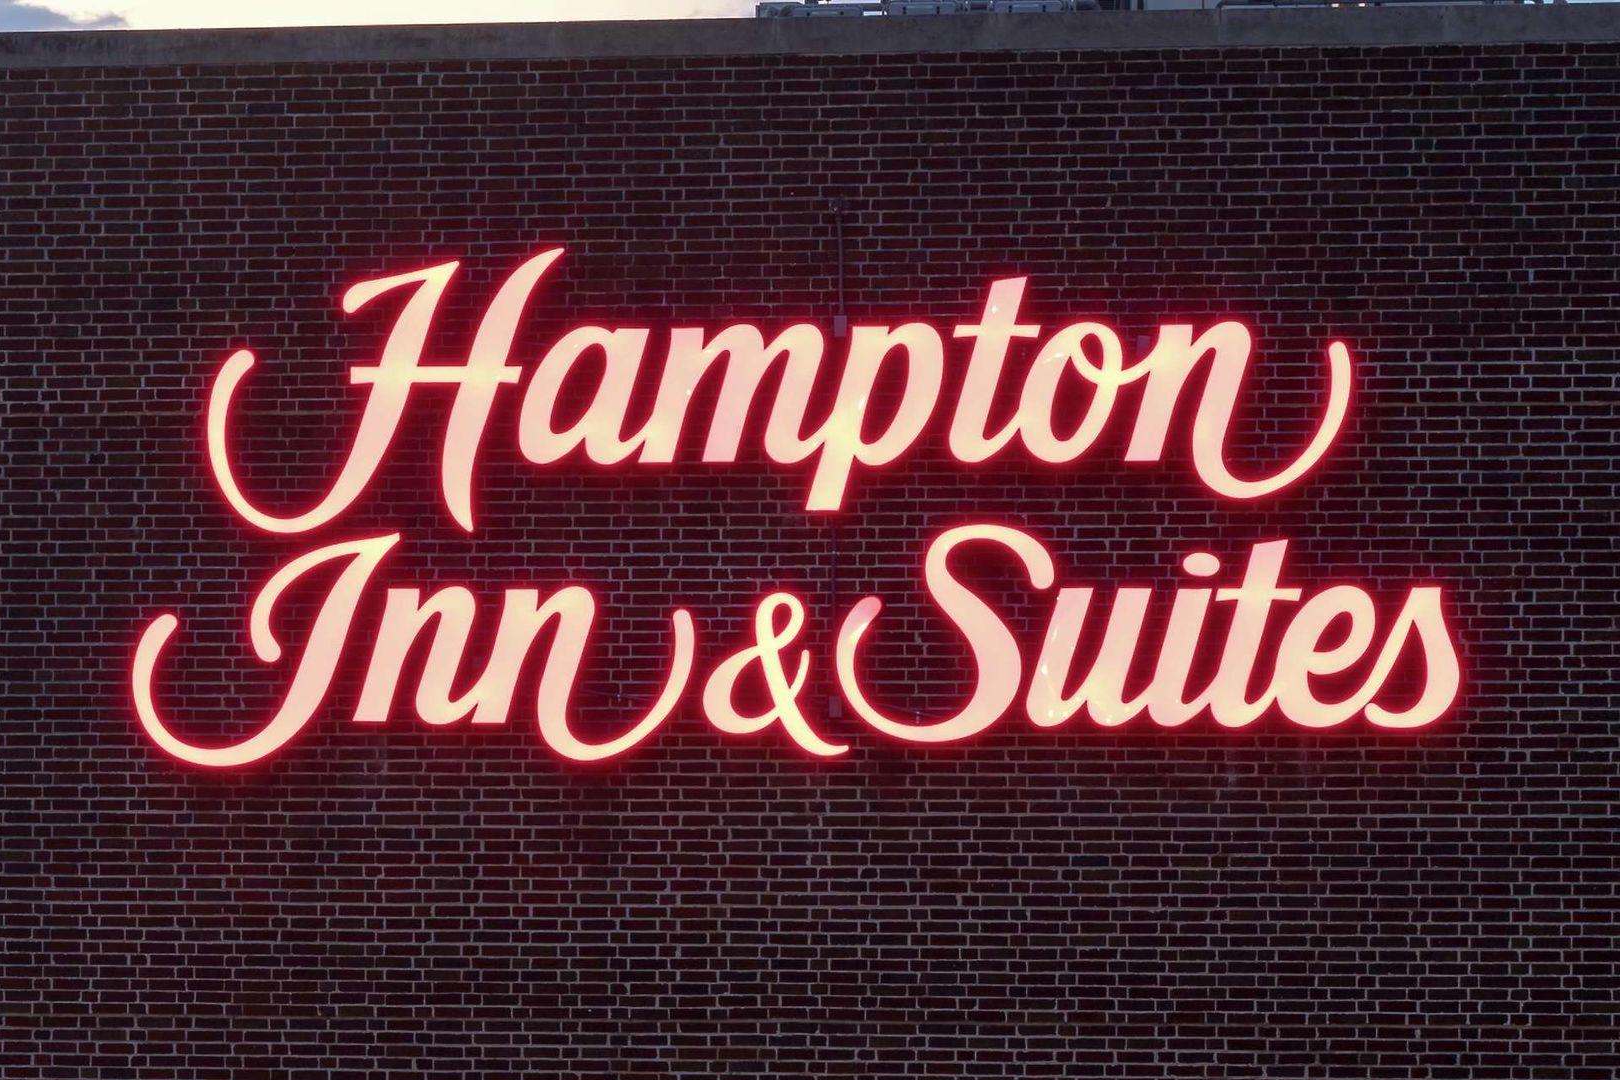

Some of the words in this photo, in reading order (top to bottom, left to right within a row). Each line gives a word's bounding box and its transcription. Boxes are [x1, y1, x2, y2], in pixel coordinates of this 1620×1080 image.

[207, 247, 1351, 534] Hampton
[132, 532, 695, 767] Inn
[702, 591, 850, 757] &
[836, 524, 1461, 743] Suites
